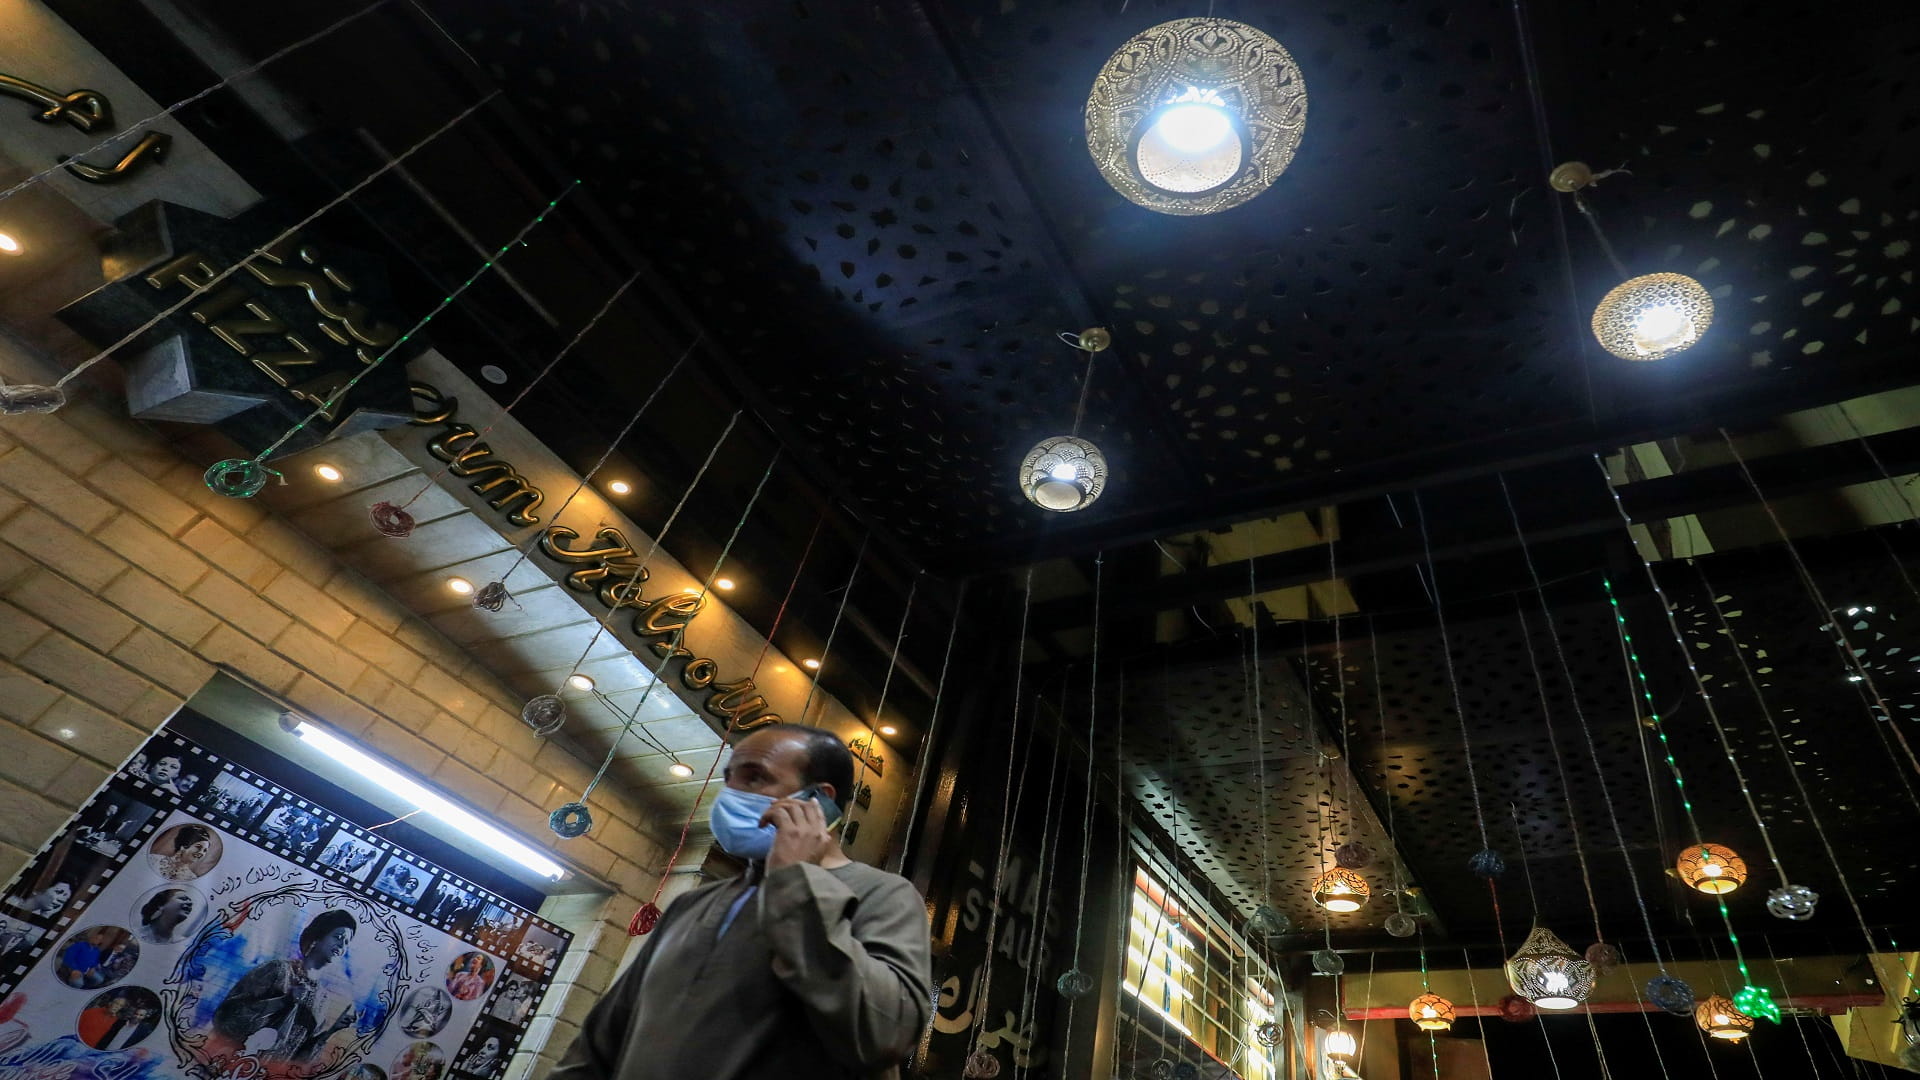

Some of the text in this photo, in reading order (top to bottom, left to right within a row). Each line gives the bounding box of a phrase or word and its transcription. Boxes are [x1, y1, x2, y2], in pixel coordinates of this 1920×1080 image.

[146, 252, 350, 422] PIZZA
[408, 380, 784, 733] Oum Kolsou
